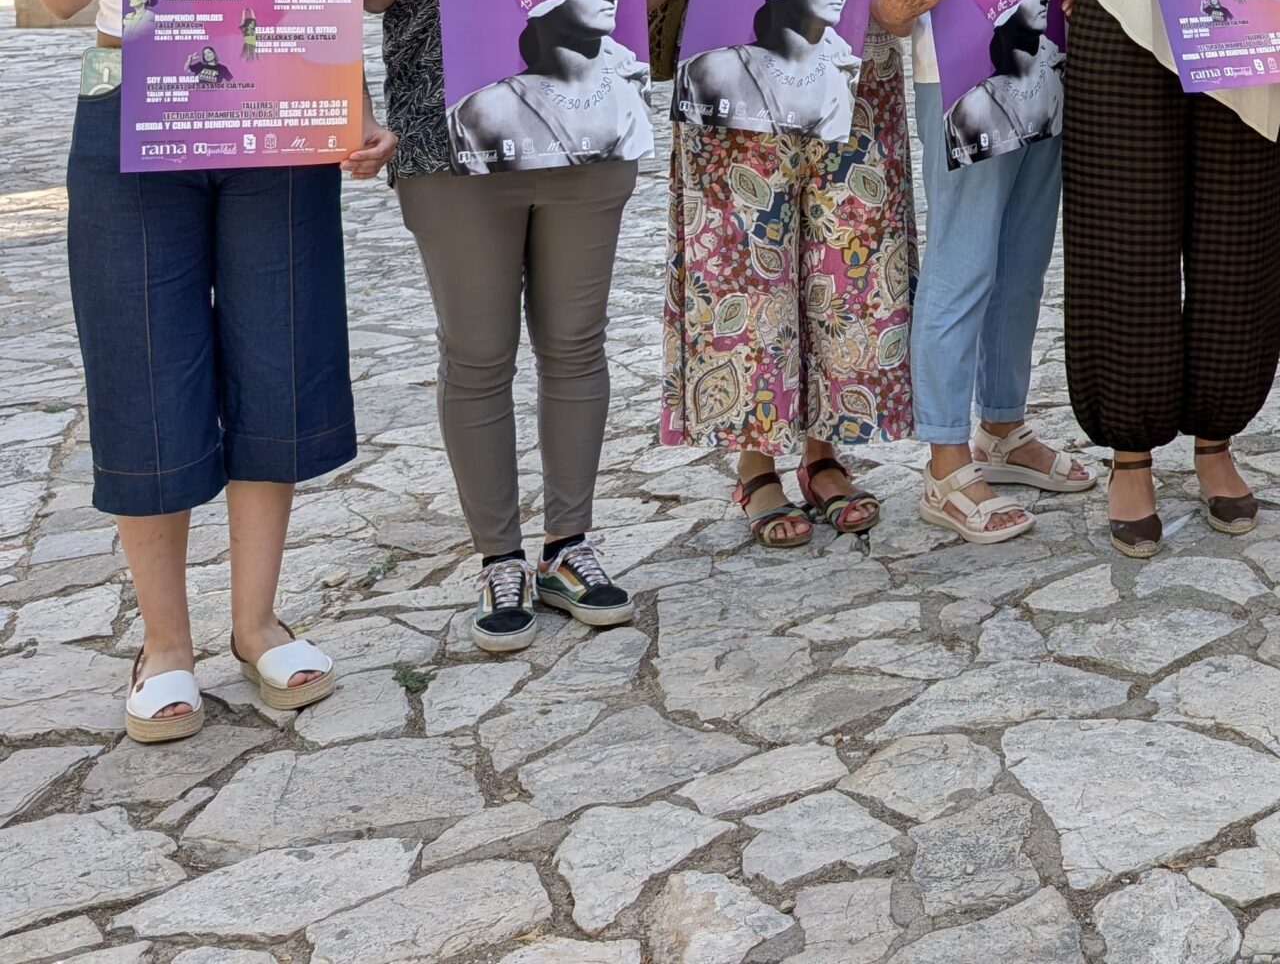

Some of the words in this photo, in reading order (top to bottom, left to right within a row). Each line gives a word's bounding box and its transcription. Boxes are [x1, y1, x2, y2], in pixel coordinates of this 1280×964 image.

[1190, 68, 1220, 79] rama
[136, 122, 163, 130] BEBIDA
[165, 122, 170, 130] Y
[172, 122, 191, 130] CENA
[194, 121, 203, 129] EN
[204, 120, 240, 128] BENEFICIO
[242, 120, 252, 128] DE
[253, 119, 282, 127] PATALEA
[284, 118, 299, 126] POR
[301, 118, 309, 126] LA
[311, 117, 348, 125] INCLUSIÓN
[142, 144, 187, 156] rama
